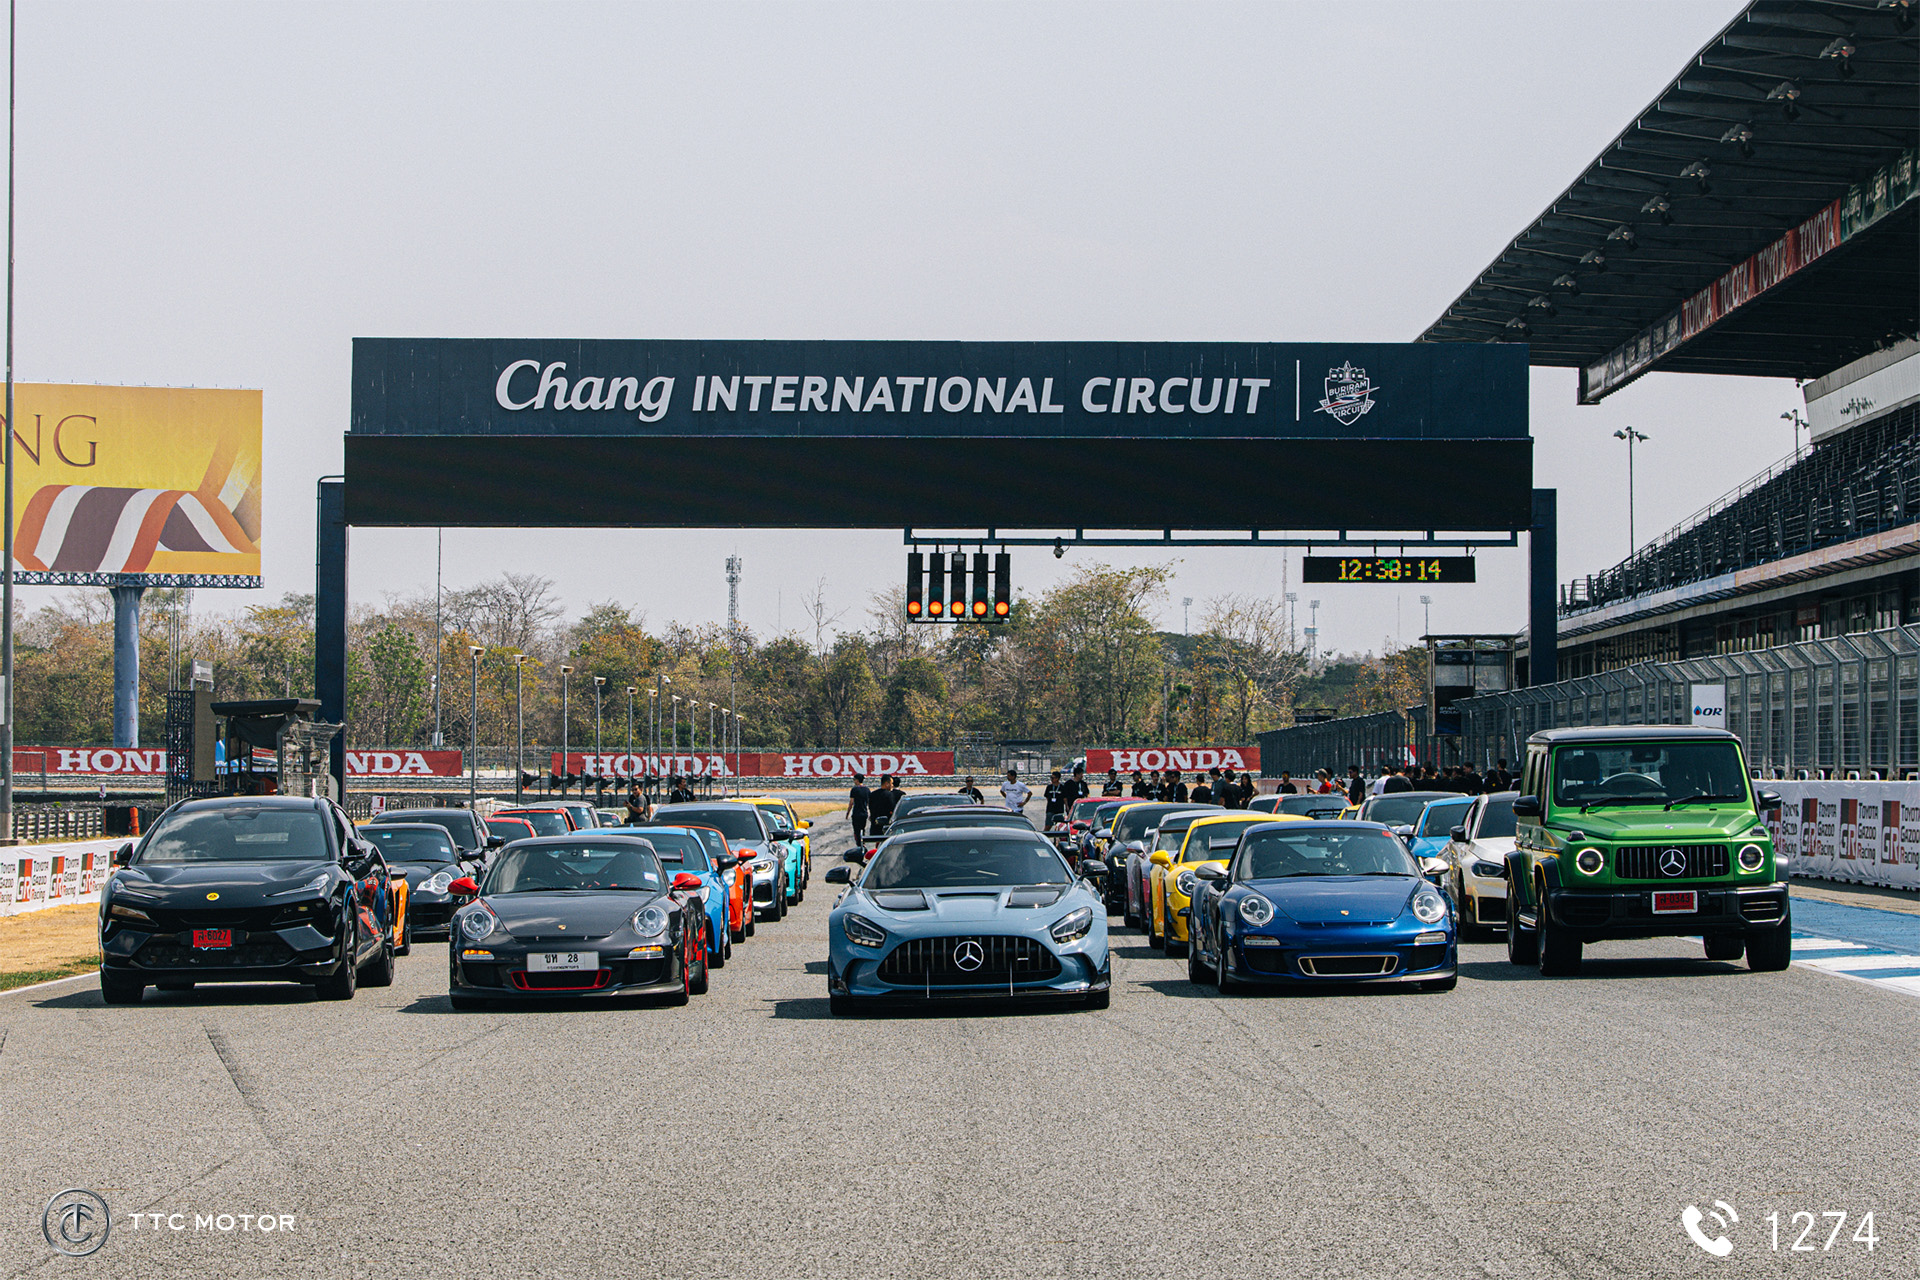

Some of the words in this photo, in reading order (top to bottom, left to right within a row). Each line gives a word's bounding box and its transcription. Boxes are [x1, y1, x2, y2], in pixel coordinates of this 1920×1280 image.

[1799, 206, 1836, 266] TOYOTA
[495, 359, 676, 423] Chang
[692, 375, 1064, 414] INTERNATIONAL
[1081, 377, 1271, 415] CIRCUIT
[1328, 380, 1367, 396] BURIRAM
[1338, 559, 1442, 581] 12:38:14
[1703, 707, 1722, 716] OR
[57, 749, 166, 773] HON
[346, 752, 433, 774] NDA
[582, 755, 734, 777] HONDA
[783, 754, 928, 776] HONDA
[1110, 749, 1245, 771] HONDA
[1859, 802, 1879, 820] TOYOTA
[1801, 822, 1816, 855] GR
[1840, 823, 1857, 858] GR
[1881, 826, 1899, 861] GR
[1857, 842, 1876, 866] Racing
[1900, 846, 1920, 870] Racing
[17, 877, 31, 901] GR
[568, 953, 579, 963] 28
